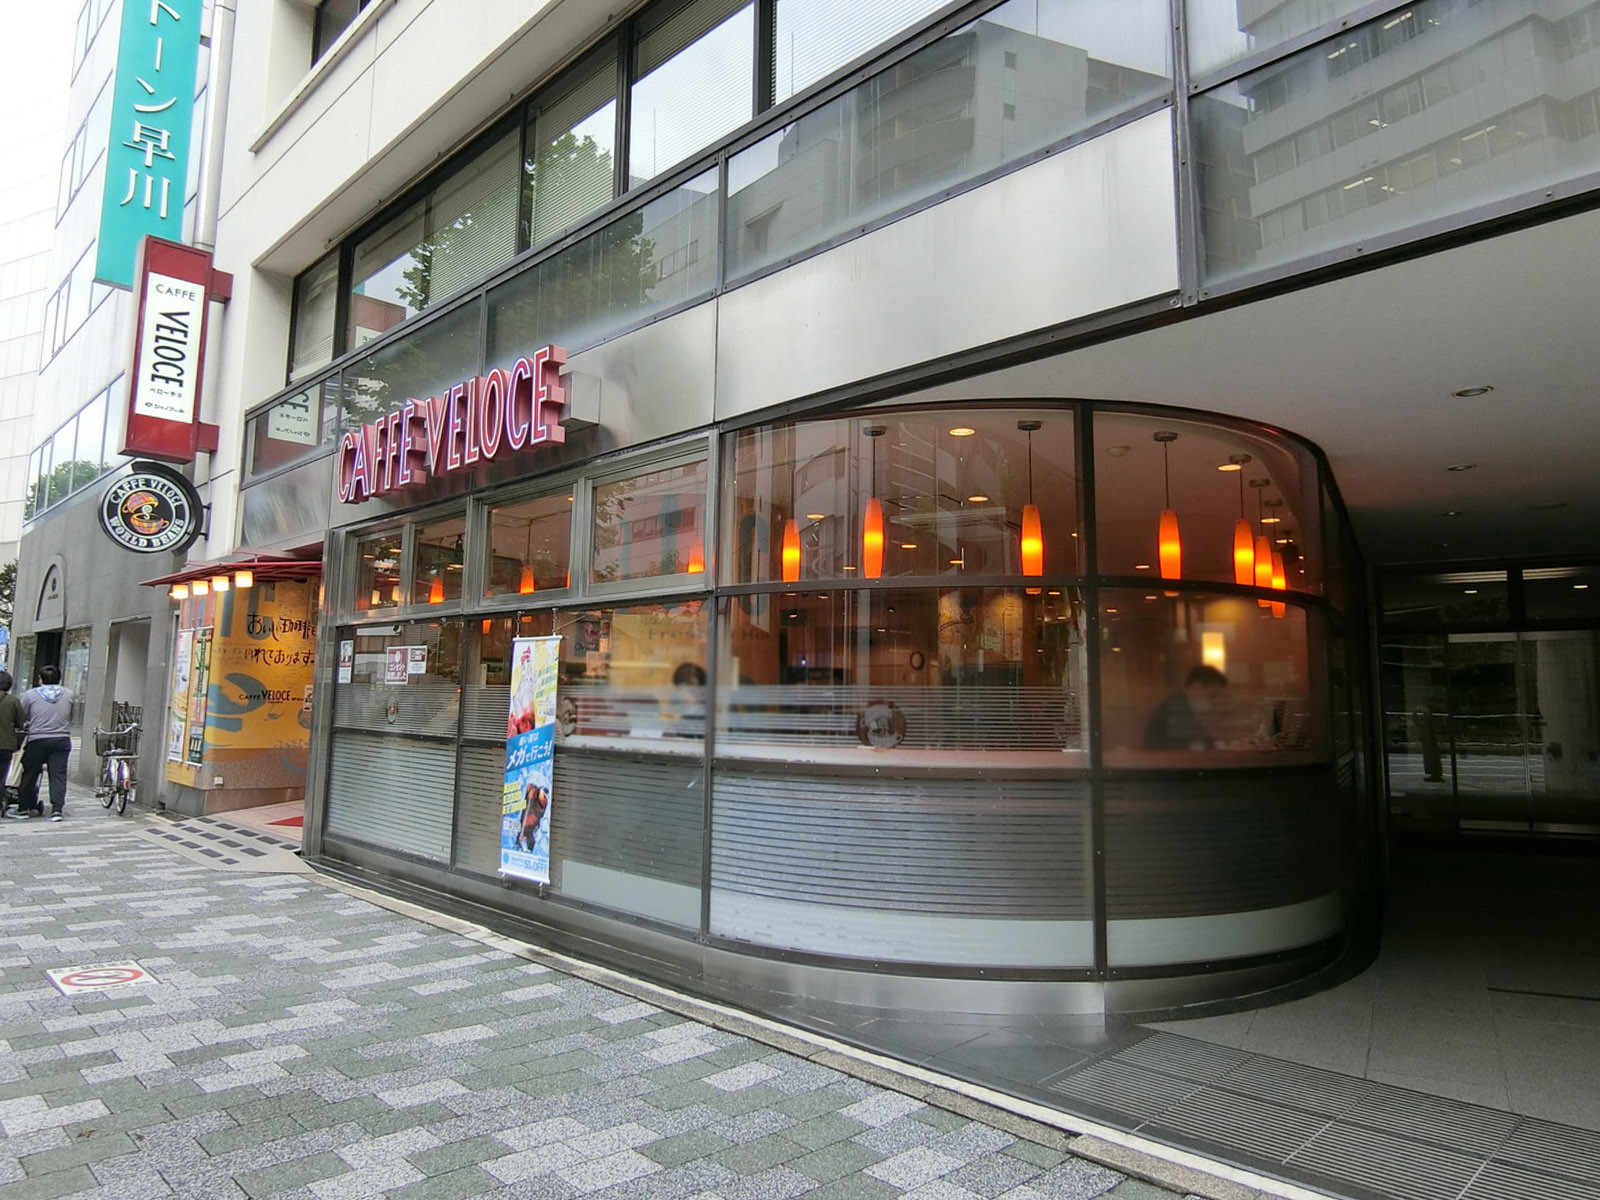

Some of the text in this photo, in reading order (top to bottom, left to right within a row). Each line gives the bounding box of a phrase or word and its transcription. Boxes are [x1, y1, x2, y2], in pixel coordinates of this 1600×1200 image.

[152, 312, 190, 388] VELOCE
[425, 344, 567, 477] VELOCE
[150, 479, 184, 507] VELOCE
[109, 516, 185, 547] WORLD BEANS
[261, 689, 291, 701] VELOCE
